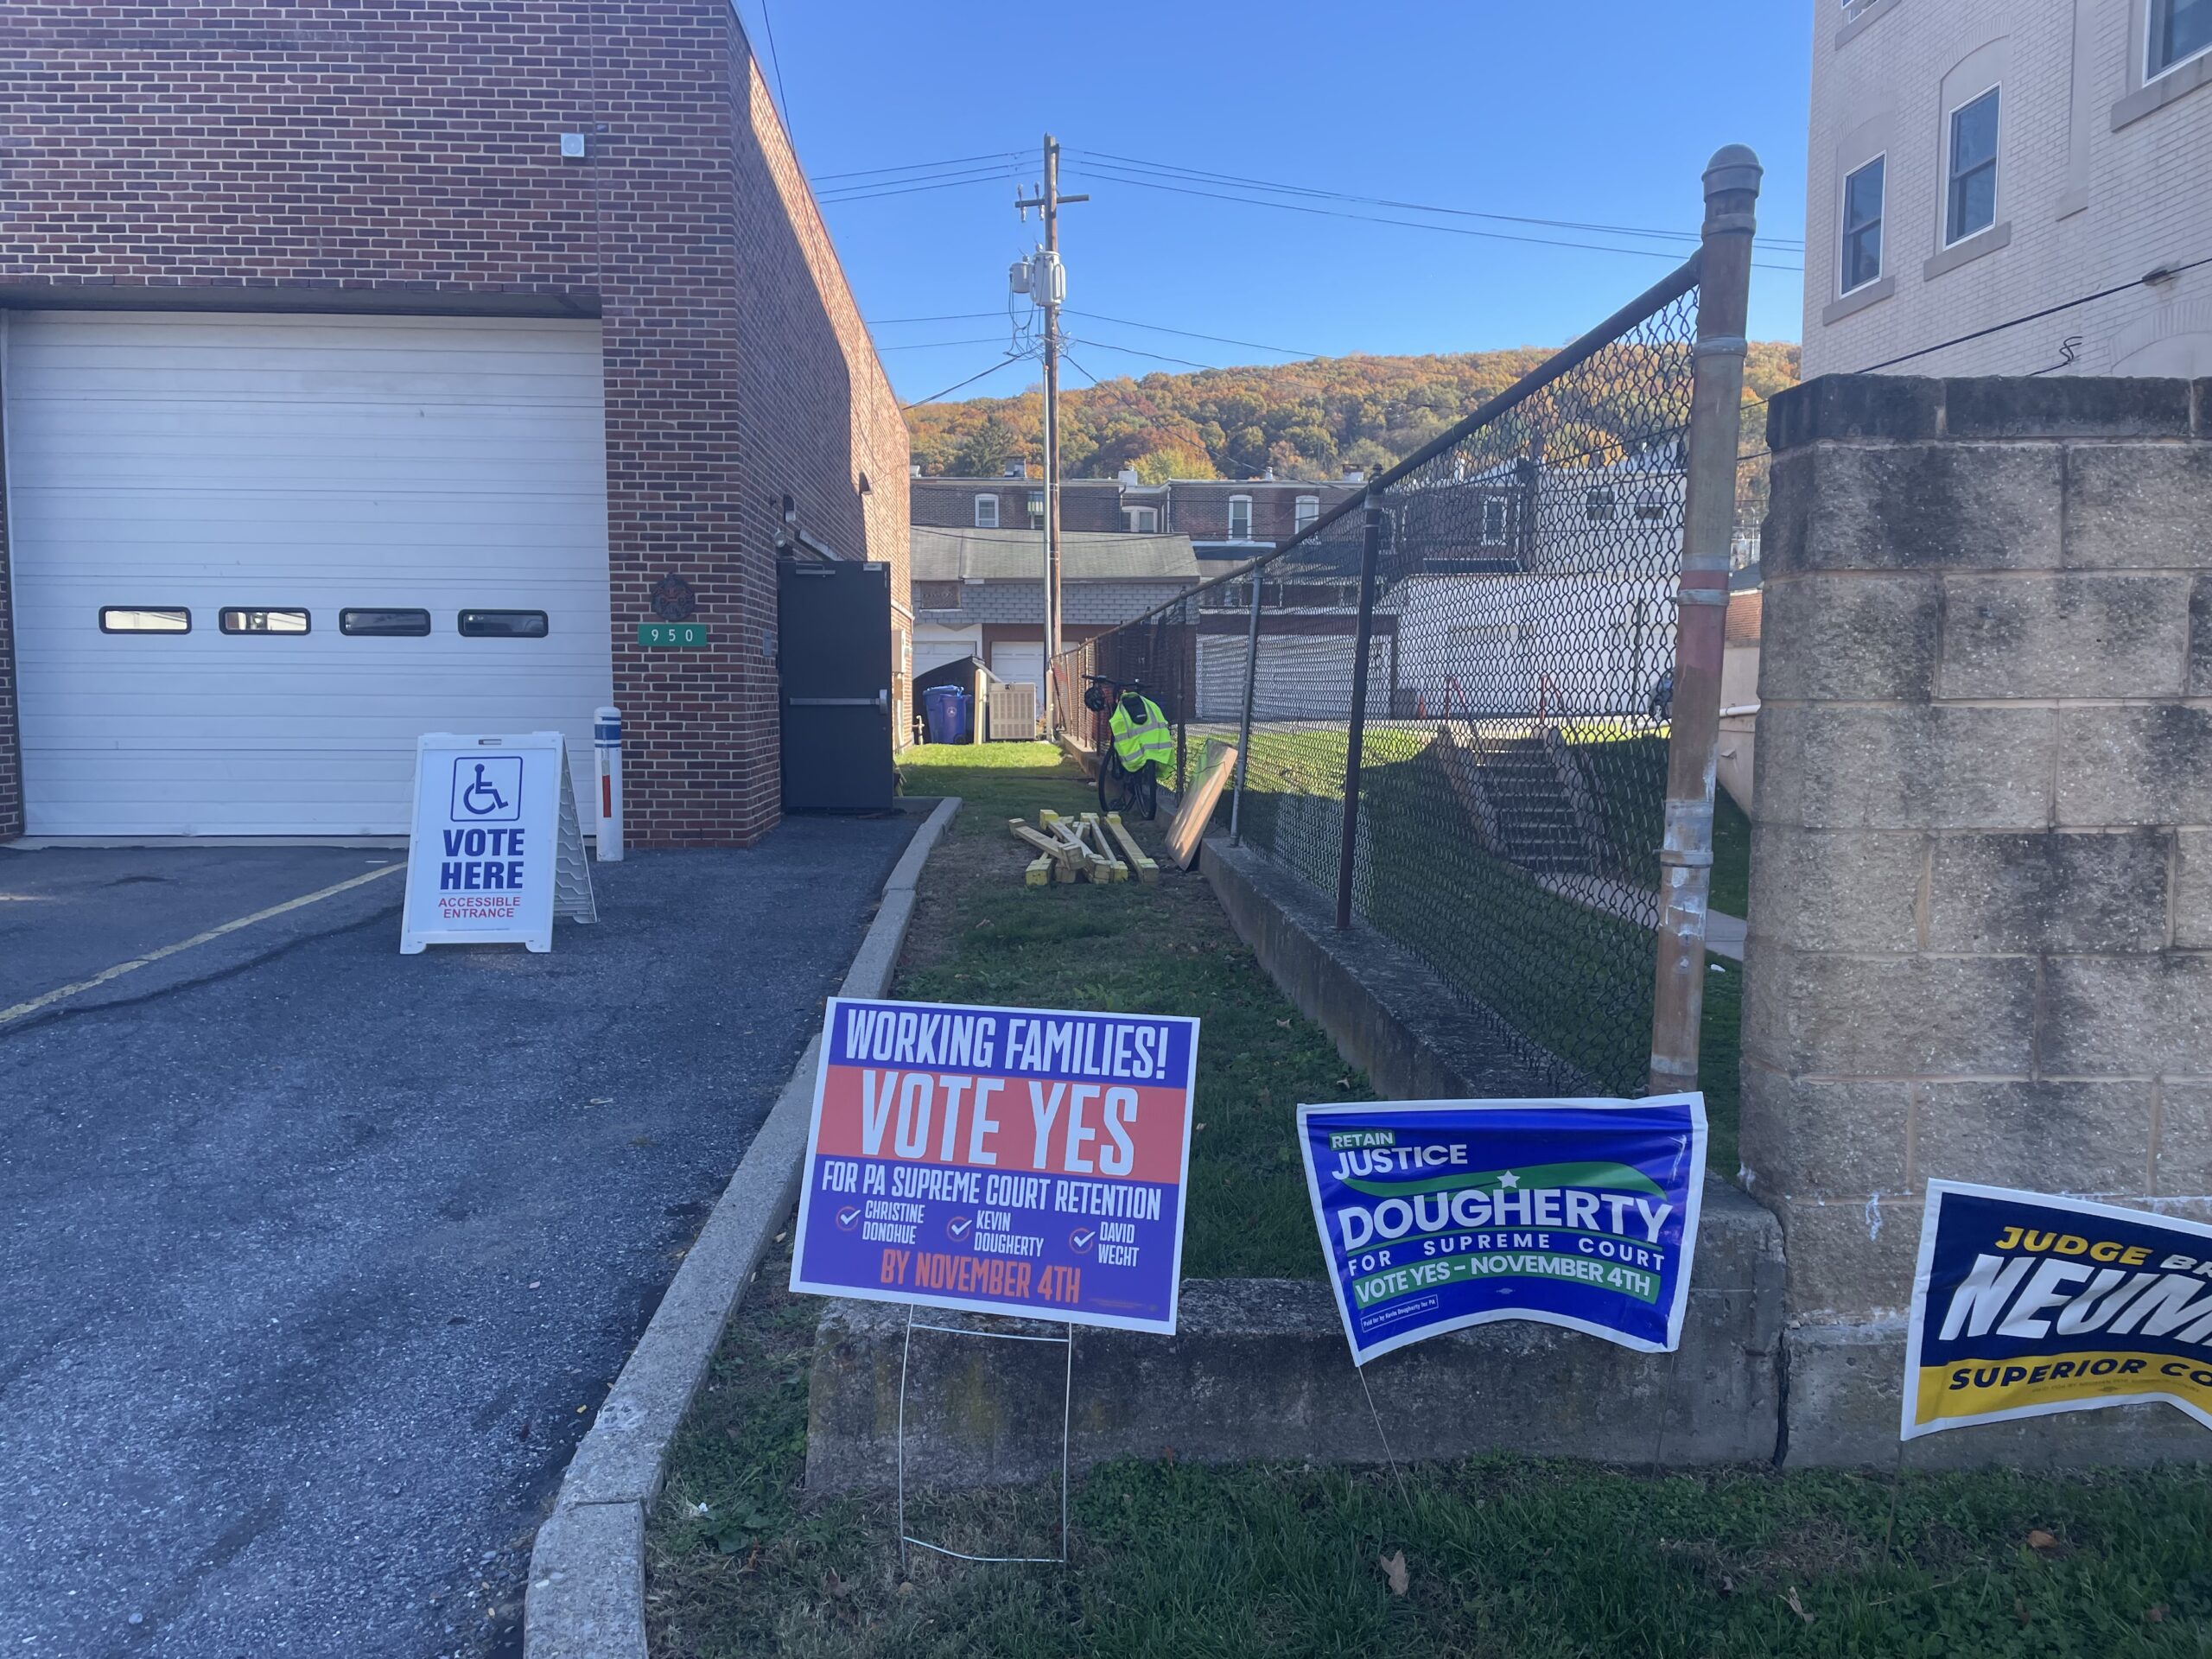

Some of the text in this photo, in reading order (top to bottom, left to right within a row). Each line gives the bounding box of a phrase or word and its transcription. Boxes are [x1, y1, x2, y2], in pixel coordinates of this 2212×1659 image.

[442, 828, 525, 857] VOTE
[440, 861, 524, 890] HERE
[438, 897, 520, 907] ACCESSIBLE
[443, 907, 514, 918] ENTRANCE
[847, 1008, 1169, 1080] WORKING FAMILIES!
[862, 1069, 1139, 1177] VOTE YES
[1331, 1132, 1395, 1149] RETAIN
[1332, 1144, 1468, 1181] JUSTICE
[822, 1160, 1161, 1220] FOR PA SUPREME COURT RETENTION
[864, 1201, 925, 1224] CHRISTINE
[976, 1211, 1011, 1232] KEVIN
[1338, 1188, 1673, 1251] DOUGHERTY
[862, 1221, 917, 1246] DONOHUE
[974, 1231, 1045, 1258] DOUGHERTY
[1099, 1221, 1135, 1244] DAVID
[1994, 1226, 2154, 1266] JUDGE
[1097, 1243, 1139, 1268] WECHT
[1348, 1233, 1665, 1277] FOR SUPREME COURT
[880, 1249, 1081, 1304] BY NOVEMBER 4TH
[1355, 1269, 1408, 1303] VOTE
[1410, 1262, 1451, 1287] YES
[1471, 1255, 1603, 1285] NOVEMBER
[1607, 1268, 1650, 1296] 4TH
[1938, 1253, 2212, 1347] NEUM
[1948, 1358, 2148, 1390] SUPERIOR
[2160, 1363, 2212, 1388] CO
